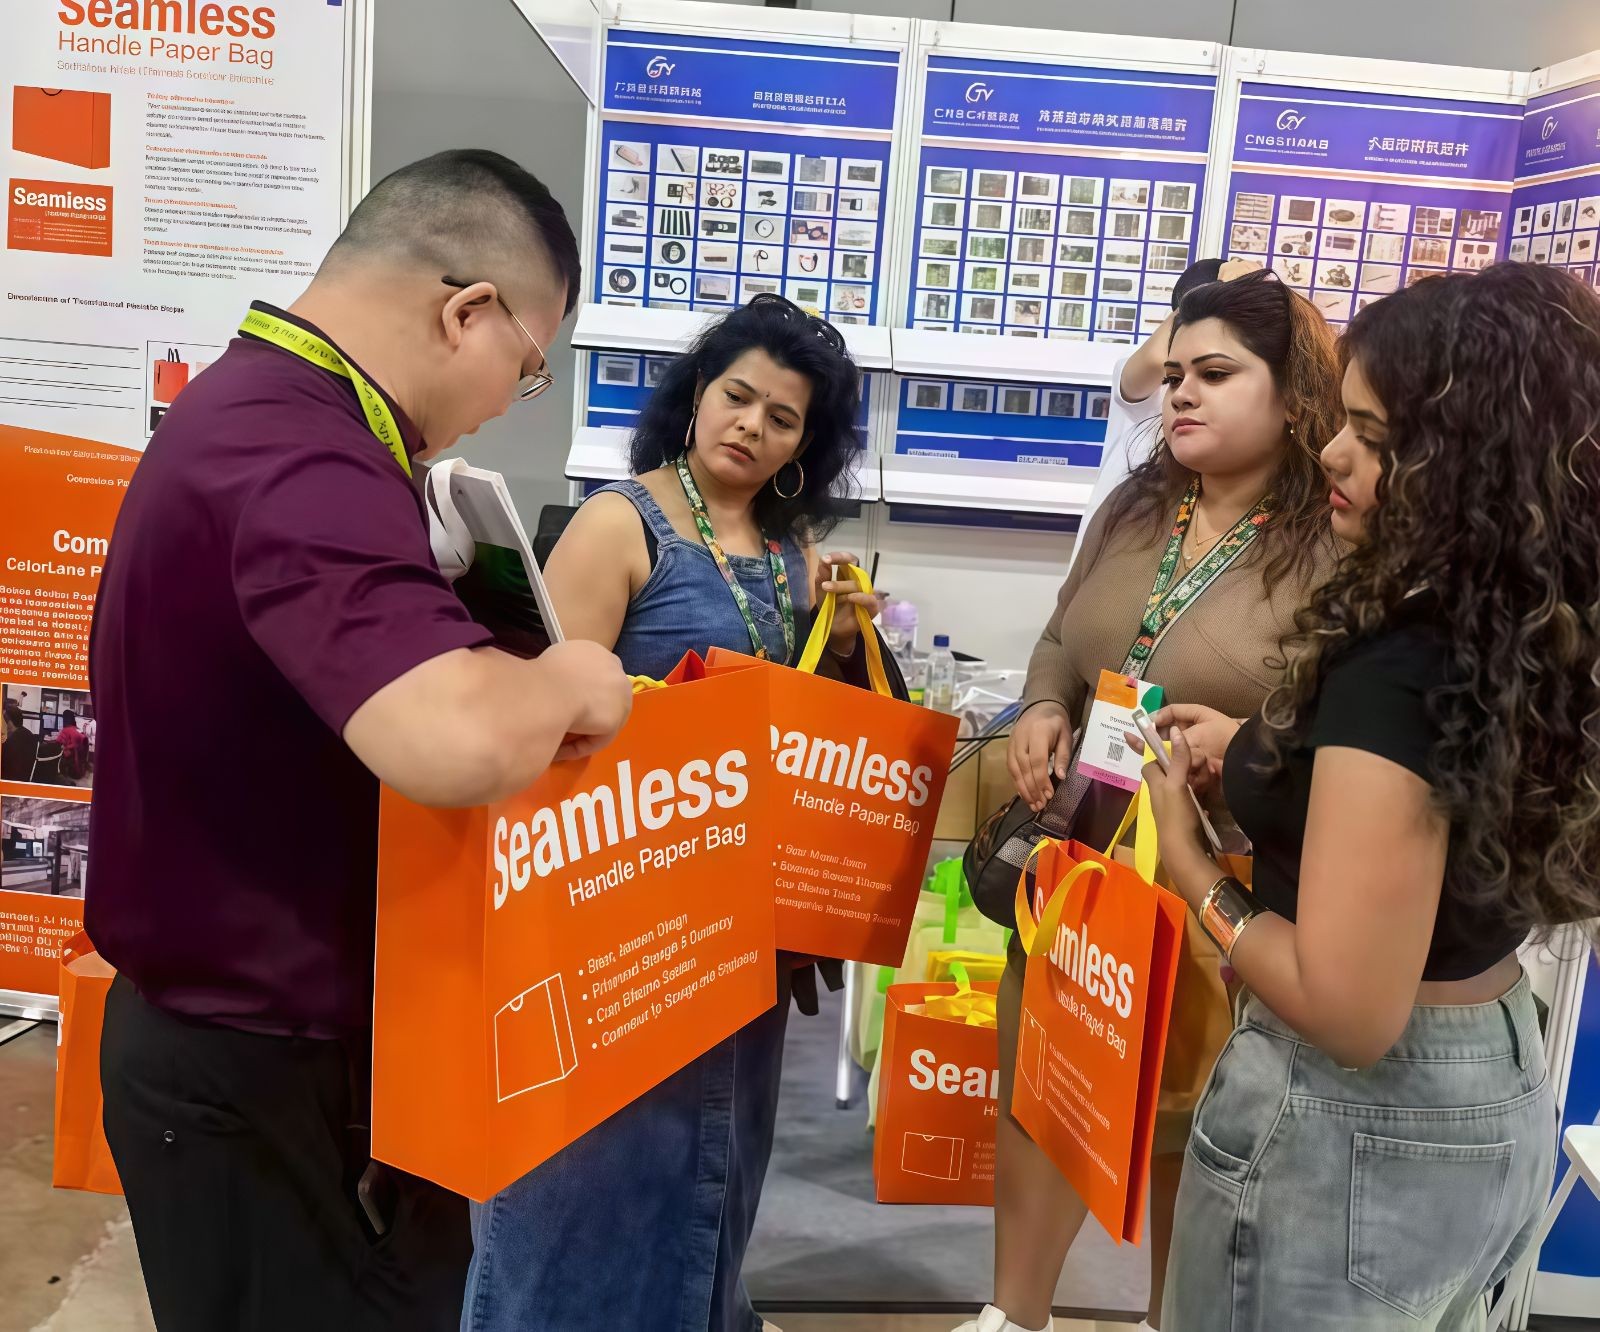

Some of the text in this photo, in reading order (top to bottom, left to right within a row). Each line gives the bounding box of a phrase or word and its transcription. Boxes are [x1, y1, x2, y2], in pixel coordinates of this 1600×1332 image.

[58, 0, 276, 39] Seamless
[58, 30, 274, 70] Handle Paper Bag
[494, 750, 749, 911] Seamless
[568, 822, 747, 907] Handle Paper Bag
[1106, 1023, 1127, 1060] Bag
